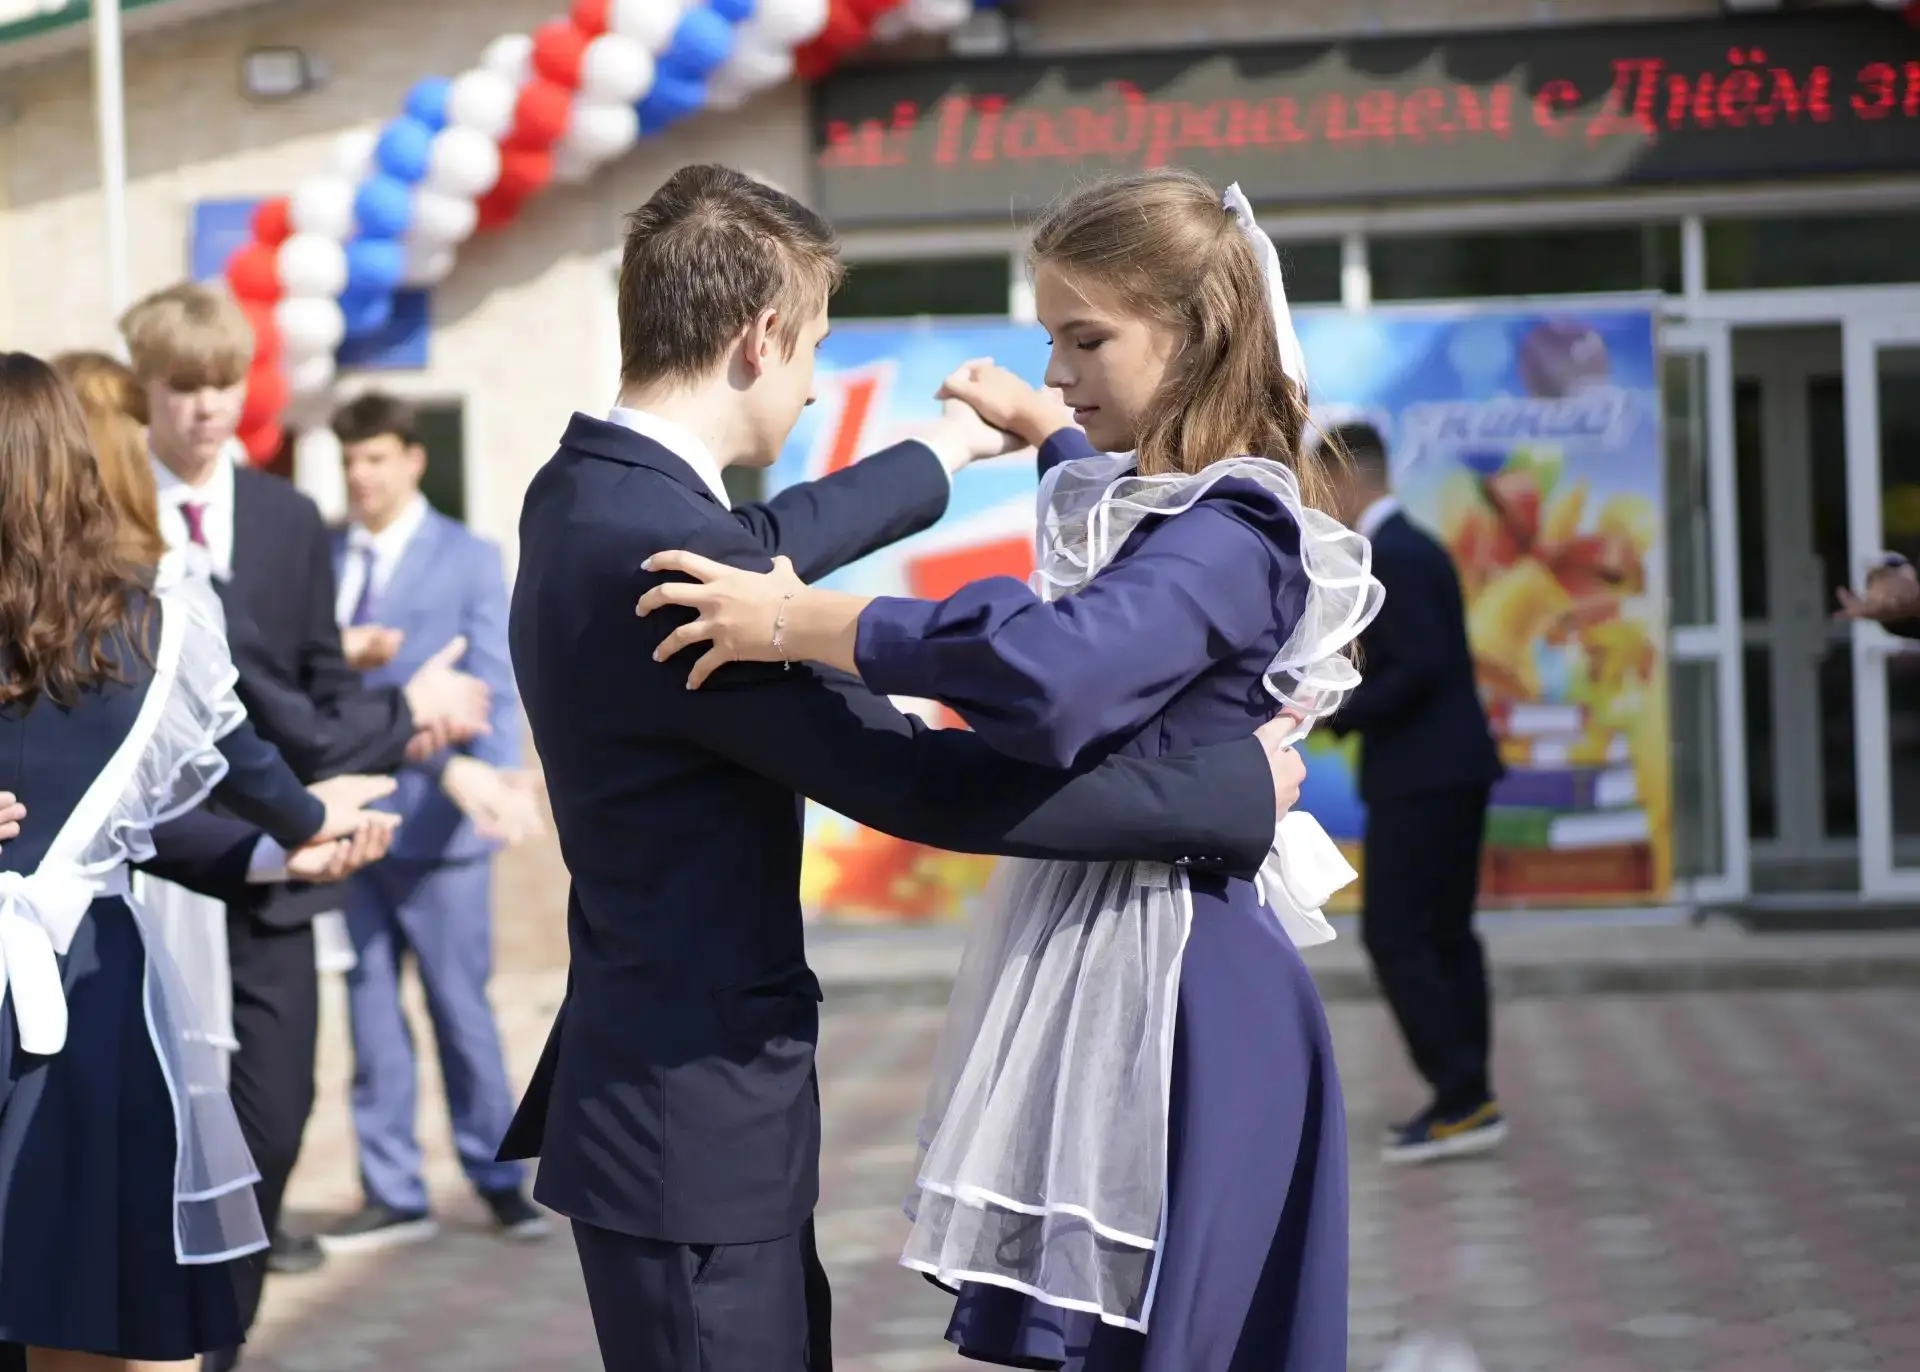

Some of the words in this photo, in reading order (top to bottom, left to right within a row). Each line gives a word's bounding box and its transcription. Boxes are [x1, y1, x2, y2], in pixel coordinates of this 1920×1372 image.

[932, 79, 1515, 170] Поздравляем
[1531, 78, 1582, 138] с
[1584, 46, 1833, 147] Днём
